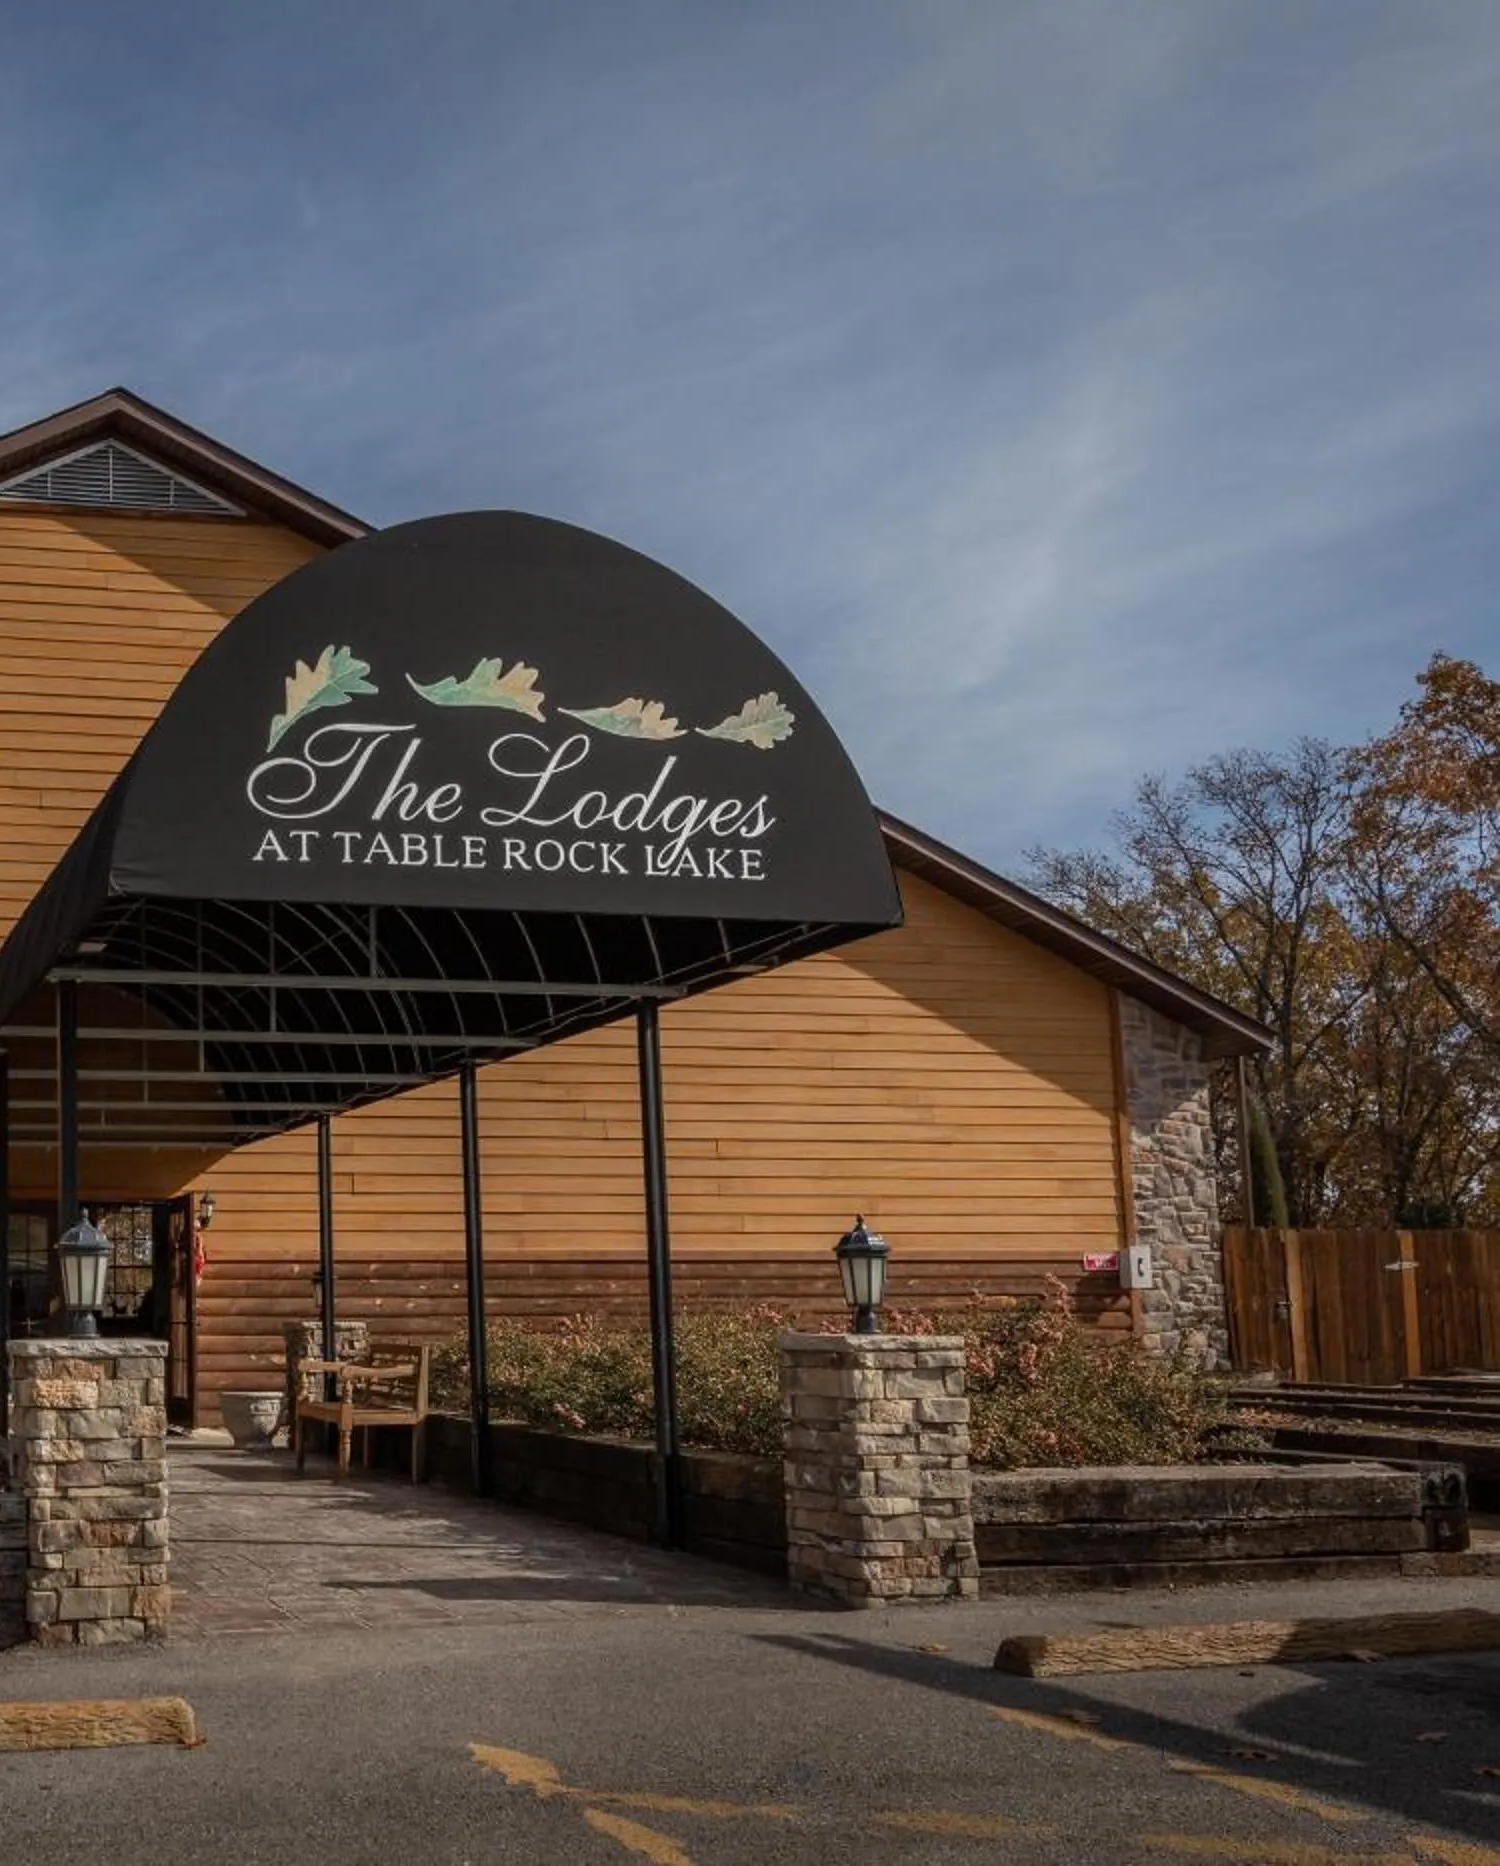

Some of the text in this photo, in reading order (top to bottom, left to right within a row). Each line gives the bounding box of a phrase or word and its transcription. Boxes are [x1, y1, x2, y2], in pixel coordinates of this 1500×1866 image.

[246, 723, 776, 869] The Lodges
[252, 829, 766, 881] AT TABLE ROCK LAKE
